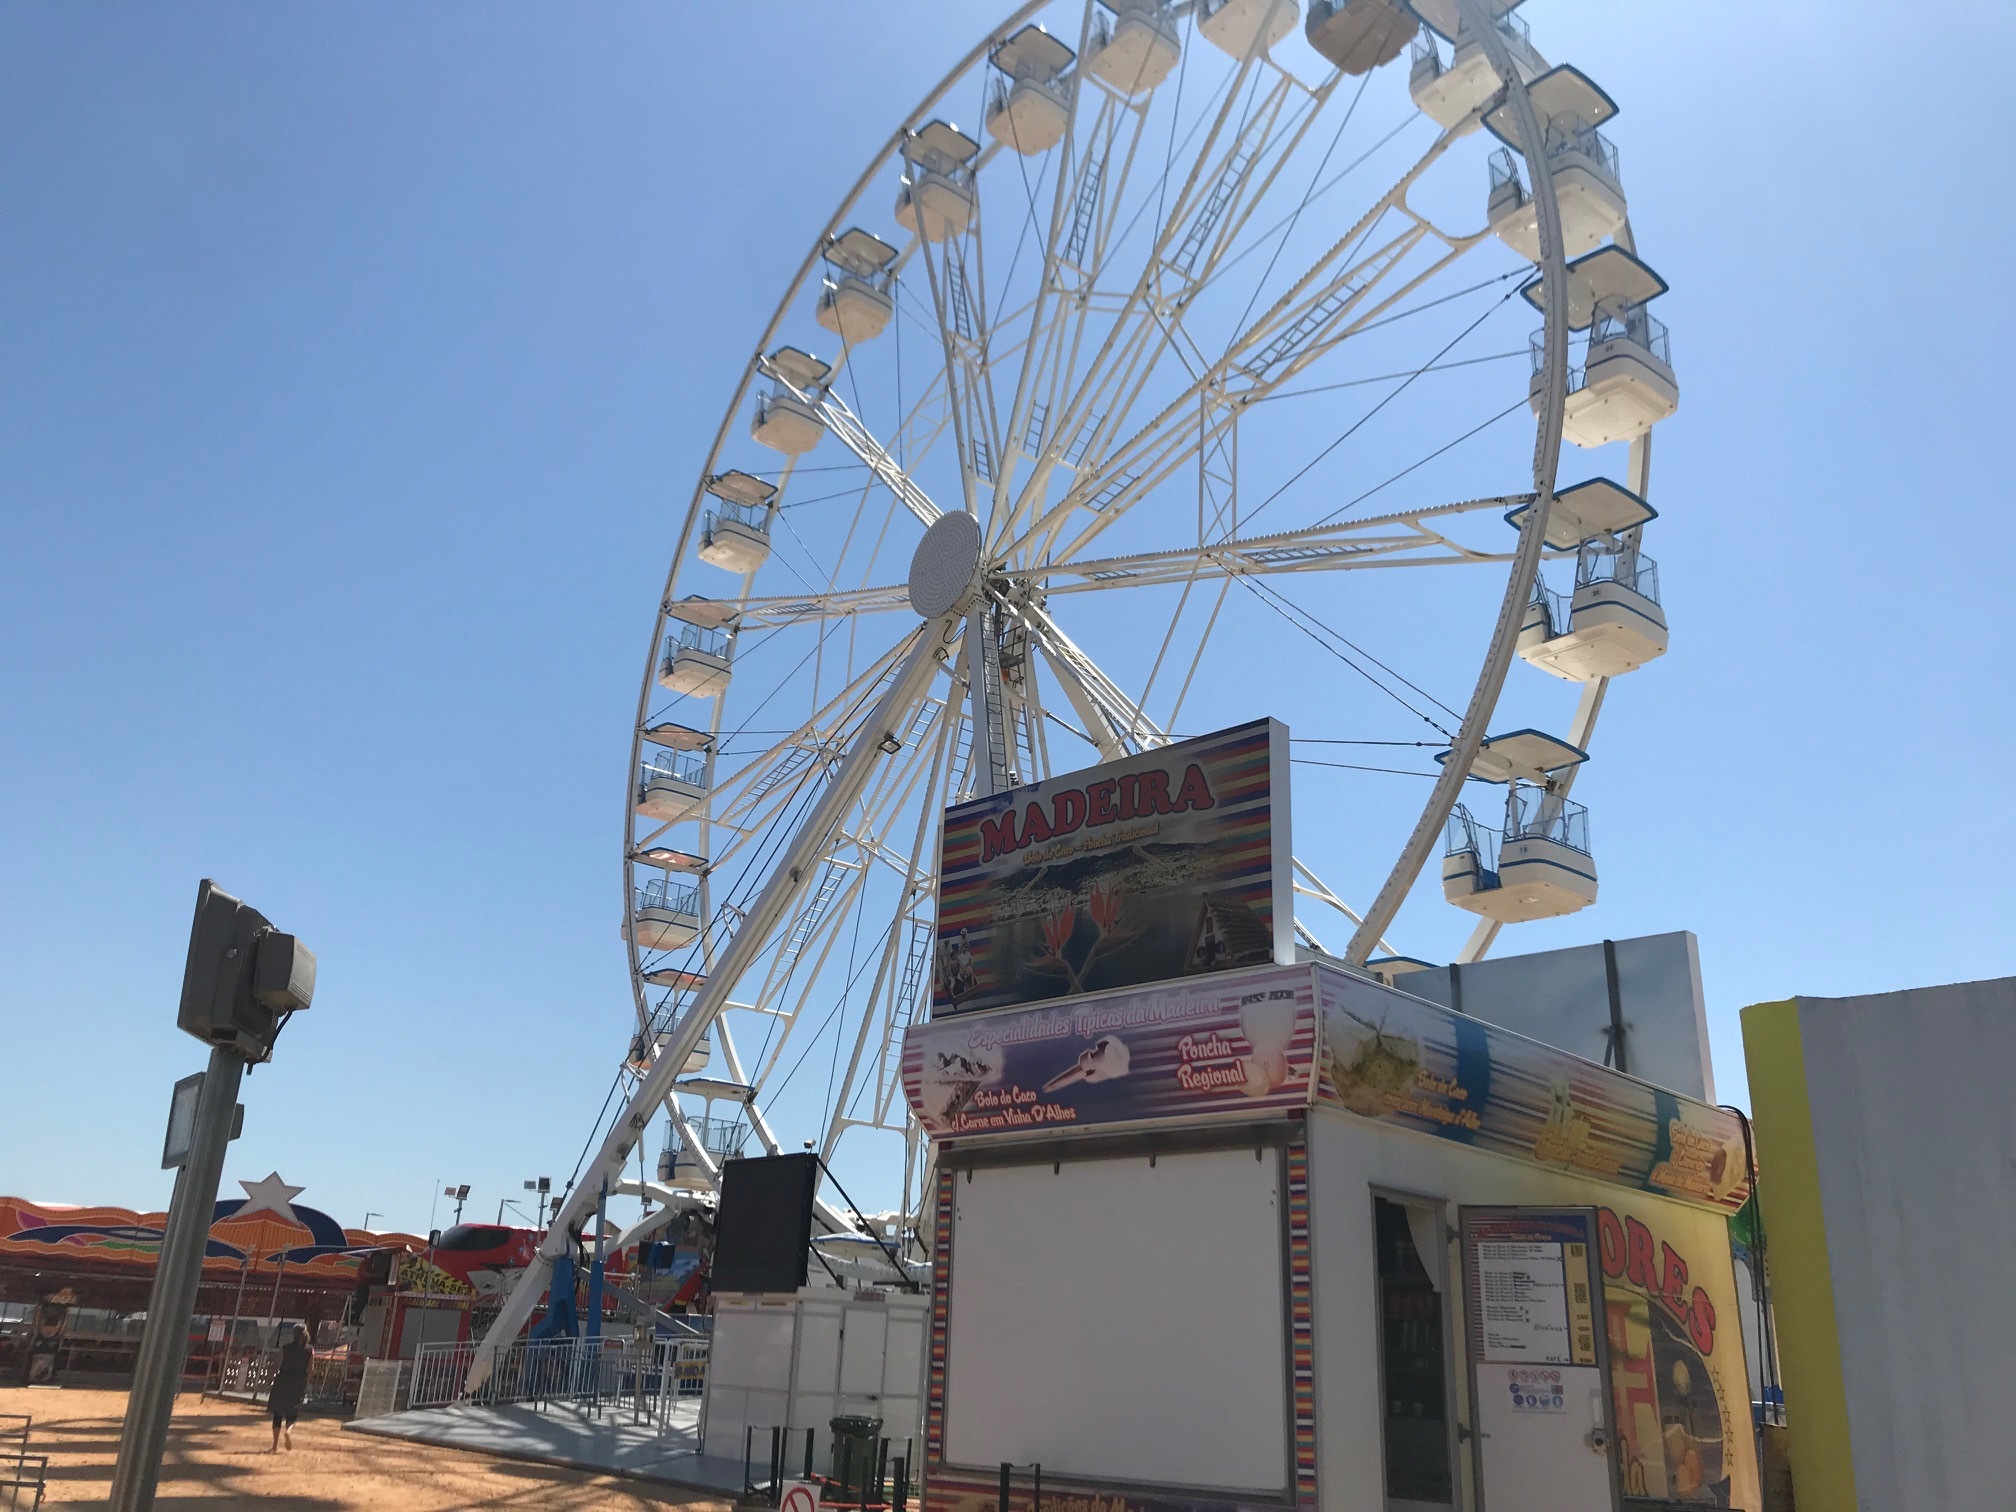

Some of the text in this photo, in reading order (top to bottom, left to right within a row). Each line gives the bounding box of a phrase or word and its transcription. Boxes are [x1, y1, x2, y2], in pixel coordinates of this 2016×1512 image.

[980, 764, 1215, 863] MADEIRA
[968, 1012, 1071, 1050] Especialidades
[1126, 997, 1146, 1026] da
[1147, 990, 1220, 1022] Madeira
[1178, 1032, 1232, 1061] Poncha
[1177, 1058, 1247, 1092] Regional
[974, 1085, 1037, 1107] Bolo do Caco
[960, 1113, 990, 1130] Carne
[990, 1115, 1005, 1127] em
[1003, 1107, 1032, 1124] Vinha
